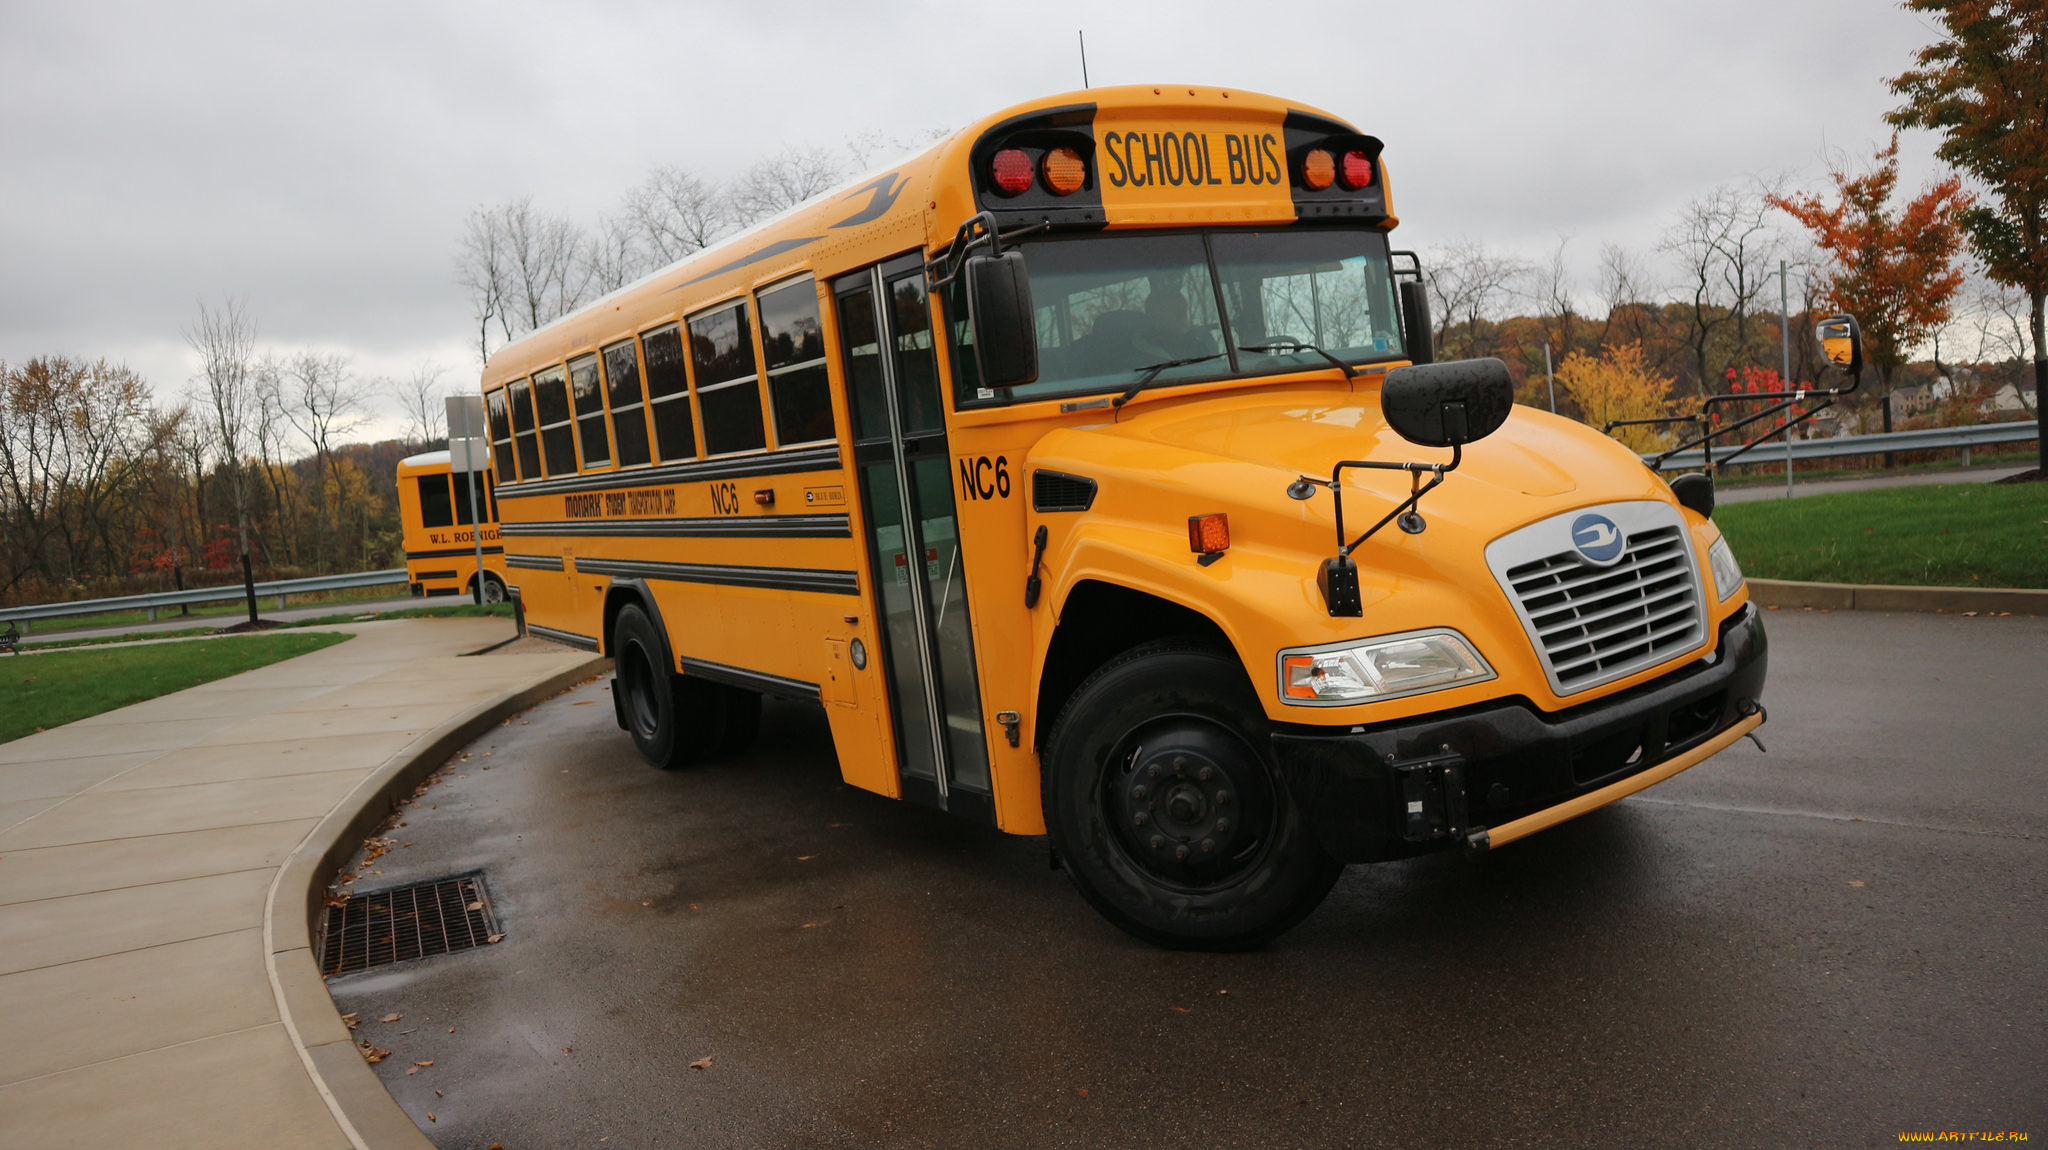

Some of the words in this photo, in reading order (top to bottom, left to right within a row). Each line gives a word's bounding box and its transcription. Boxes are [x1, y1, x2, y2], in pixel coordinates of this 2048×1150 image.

[1105, 131, 1222, 187] SCHOOL
[1225, 133, 1281, 185] BUS
[960, 455, 1010, 501] NC6
[710, 483, 739, 515] NC6
[429, 533, 451, 544] W.L.
